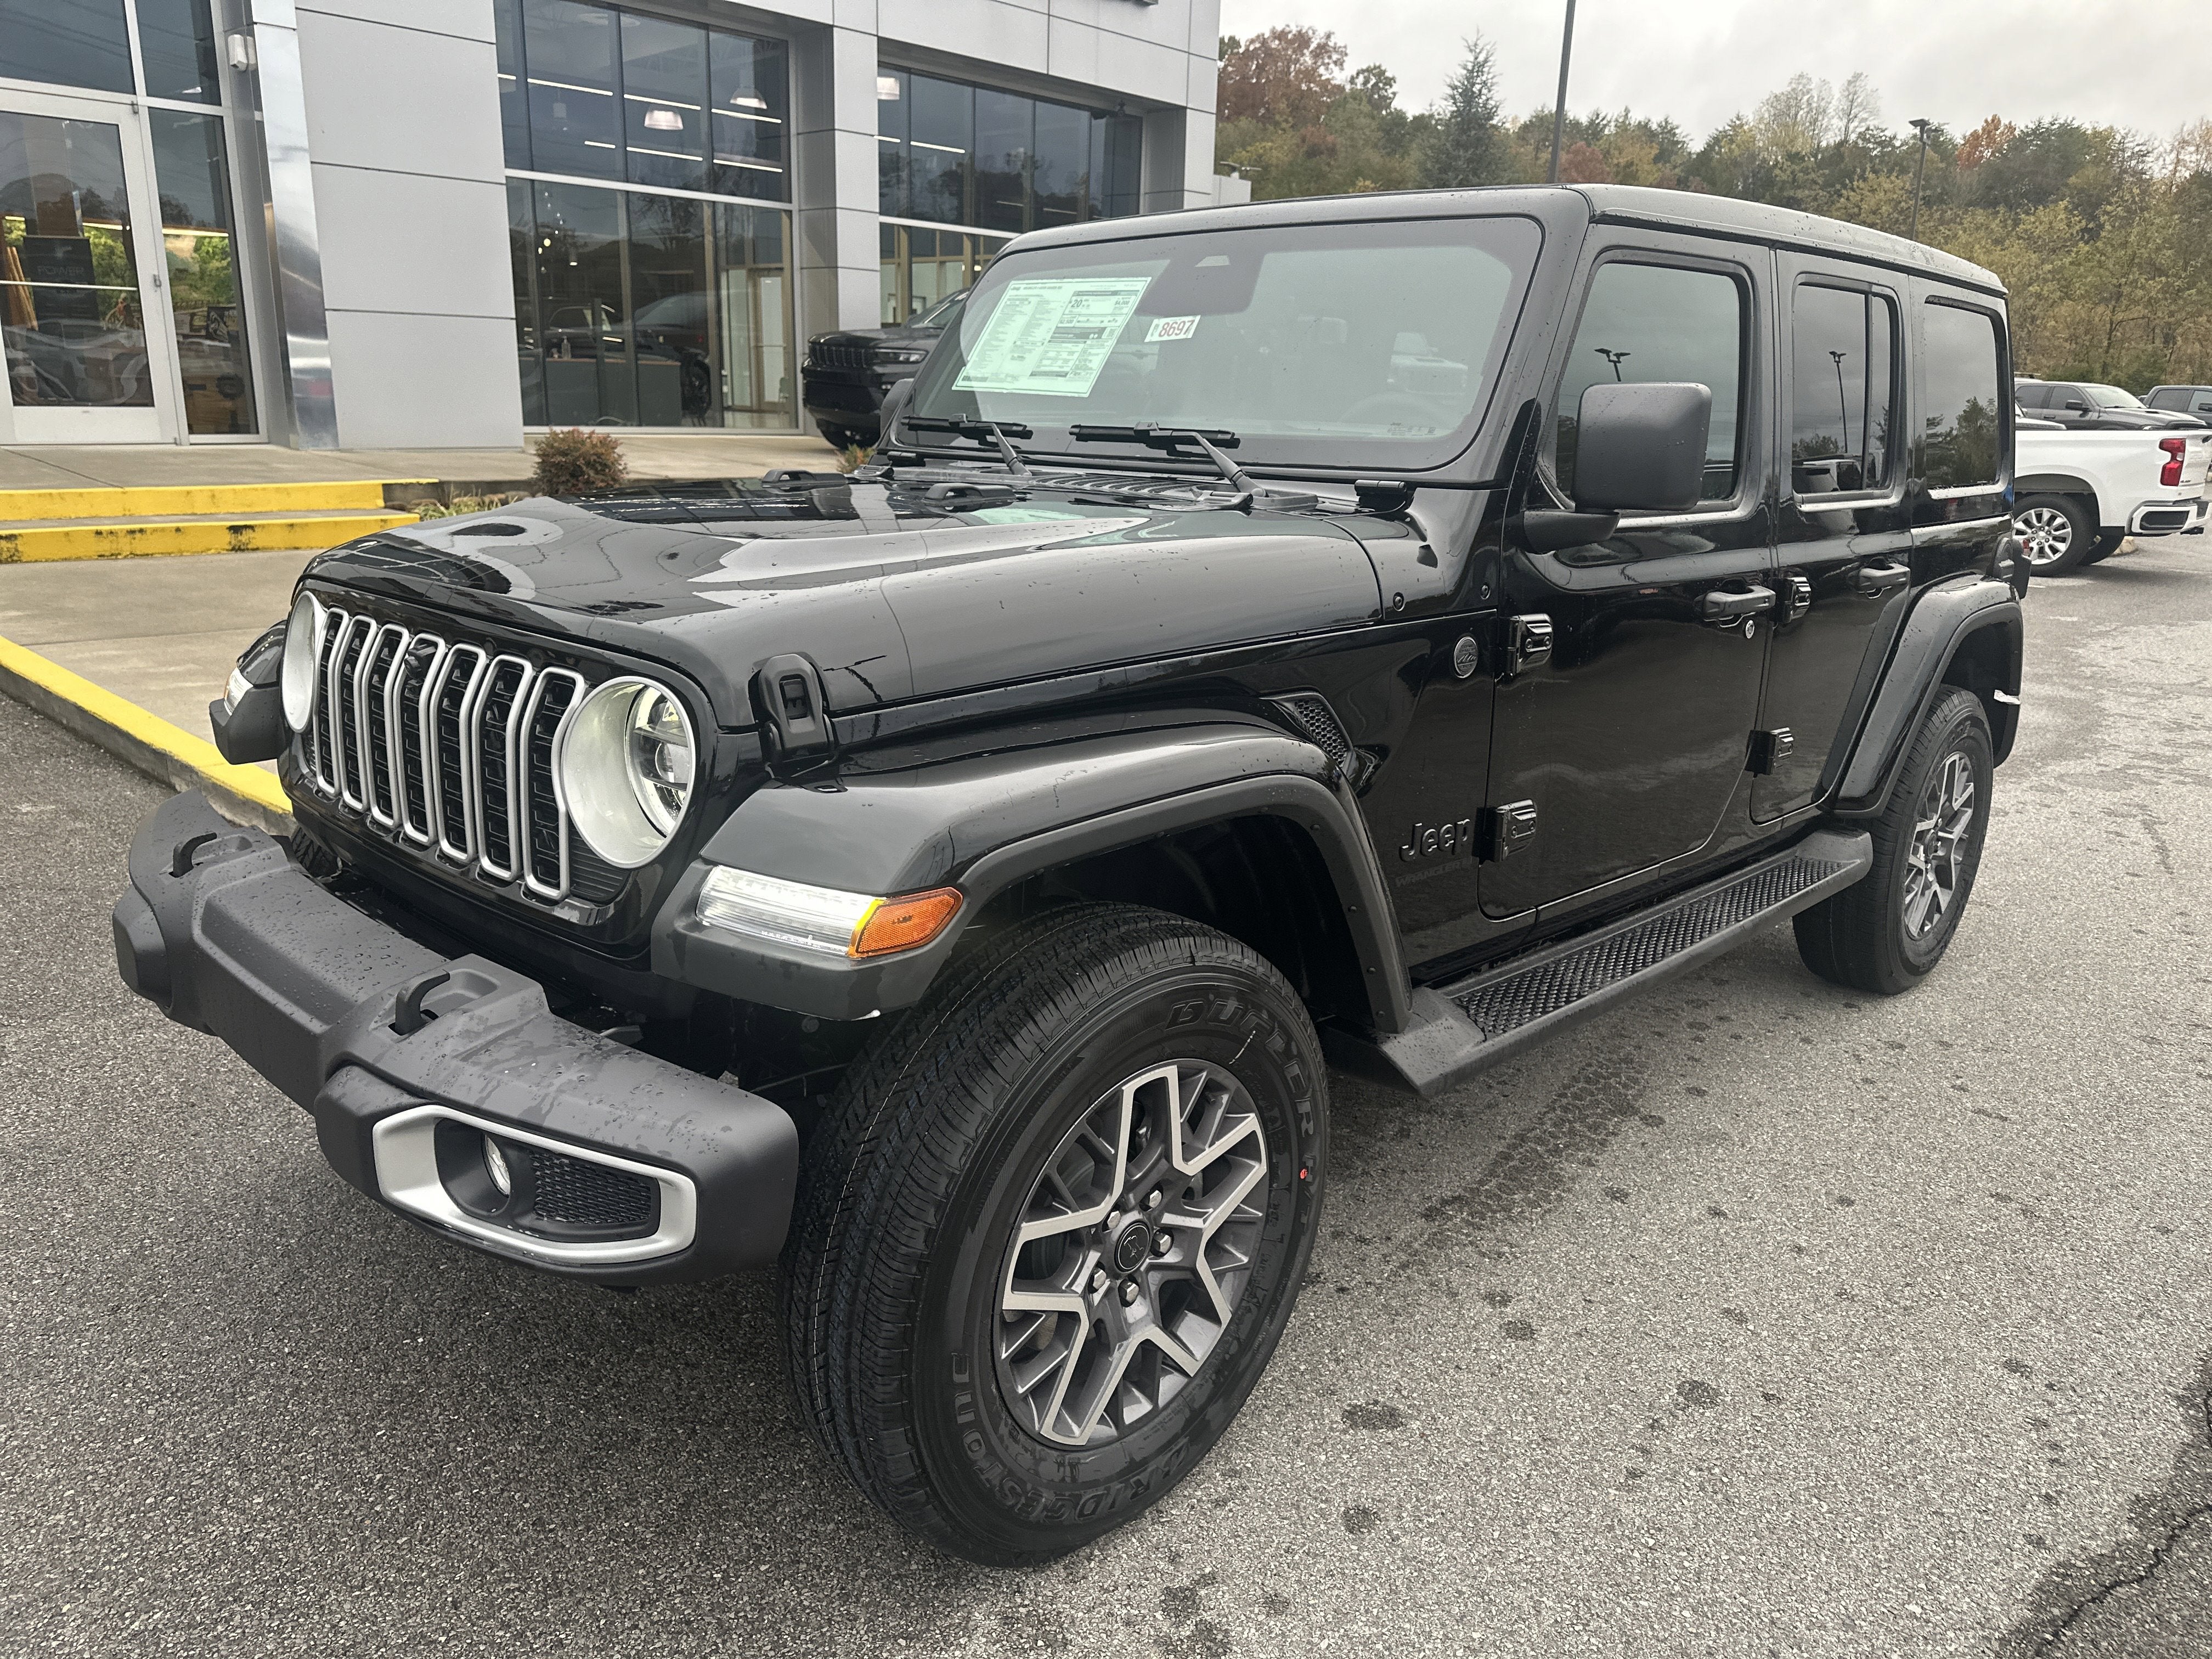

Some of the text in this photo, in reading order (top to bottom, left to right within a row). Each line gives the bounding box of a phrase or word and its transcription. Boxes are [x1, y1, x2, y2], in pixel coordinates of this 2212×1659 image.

[1158, 319, 1195, 337] 8697
[1399, 819, 1471, 862] Jeep
[1165, 998, 1314, 1138] DUELER
[951, 1352, 1189, 1523] BRIDGESTONE
